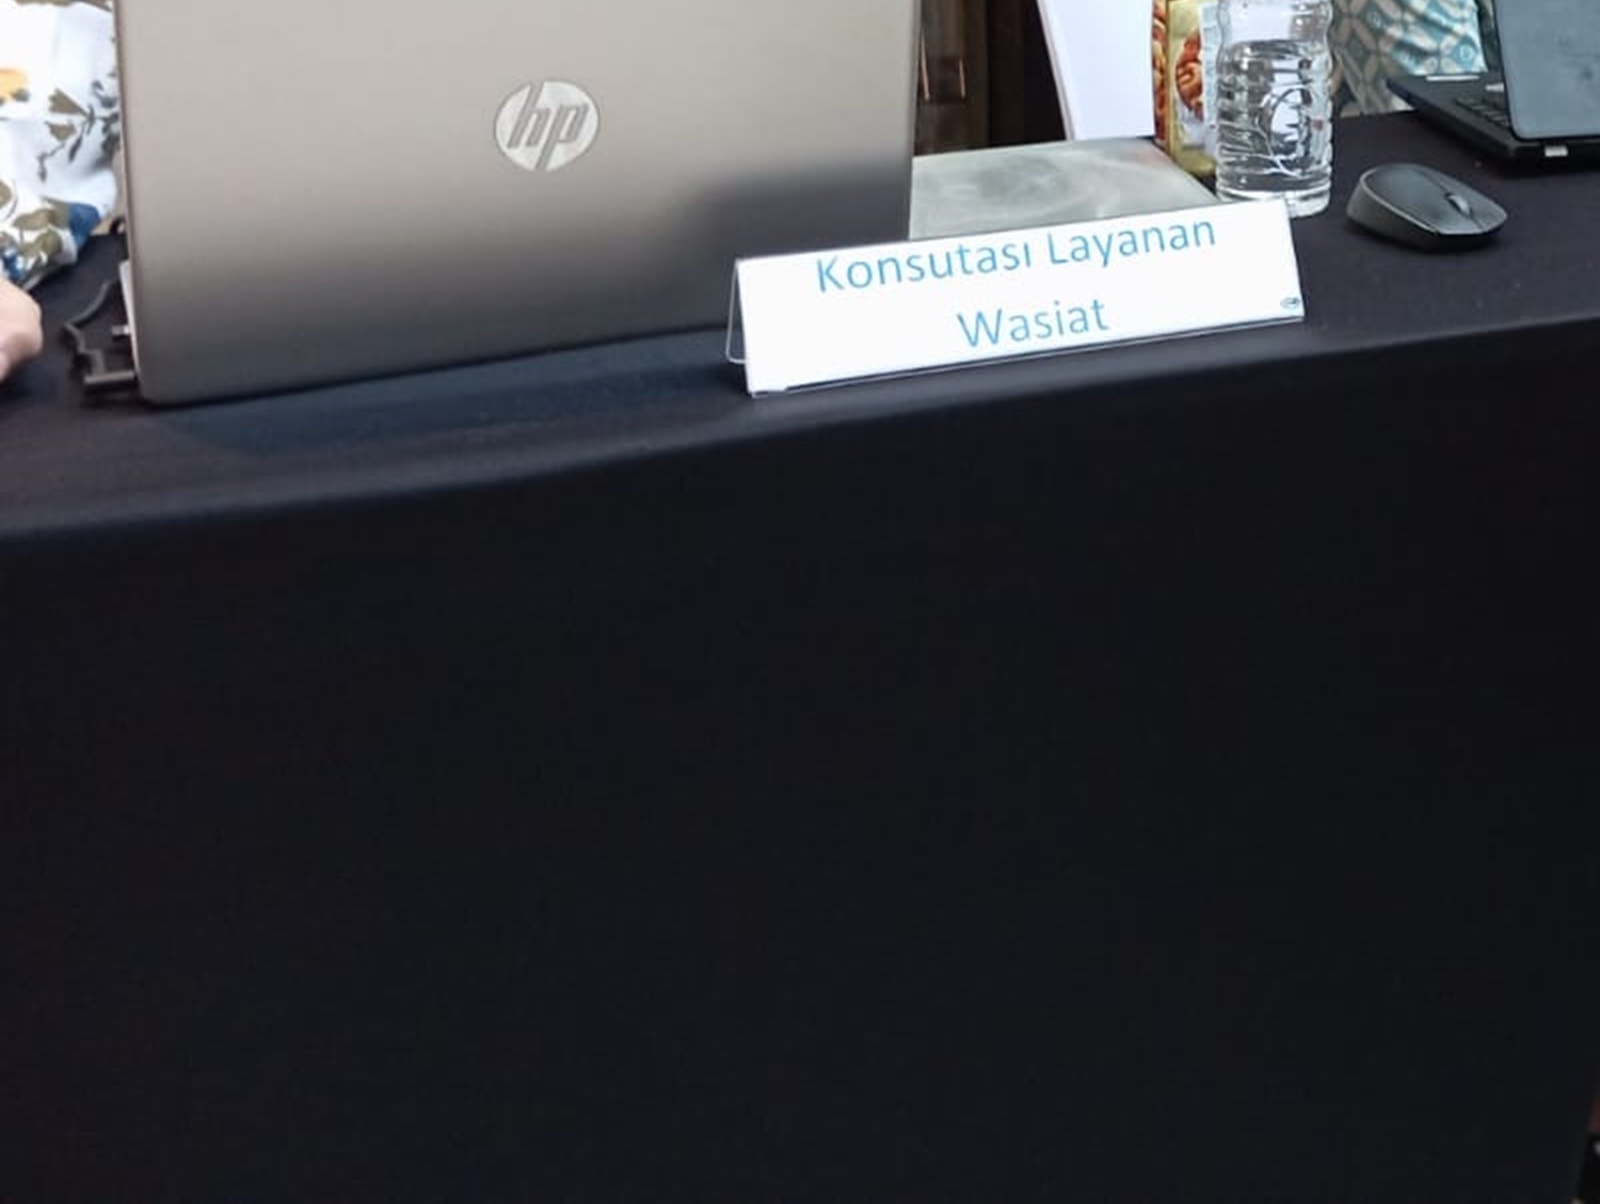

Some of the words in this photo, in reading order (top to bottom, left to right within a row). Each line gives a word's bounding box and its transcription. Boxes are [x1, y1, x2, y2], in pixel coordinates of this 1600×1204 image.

[500, 80, 594, 172] hp
[815, 242, 1034, 294] Konsutasi
[1046, 218, 1217, 270] Layanan
[956, 298, 1111, 349] Wasiat
